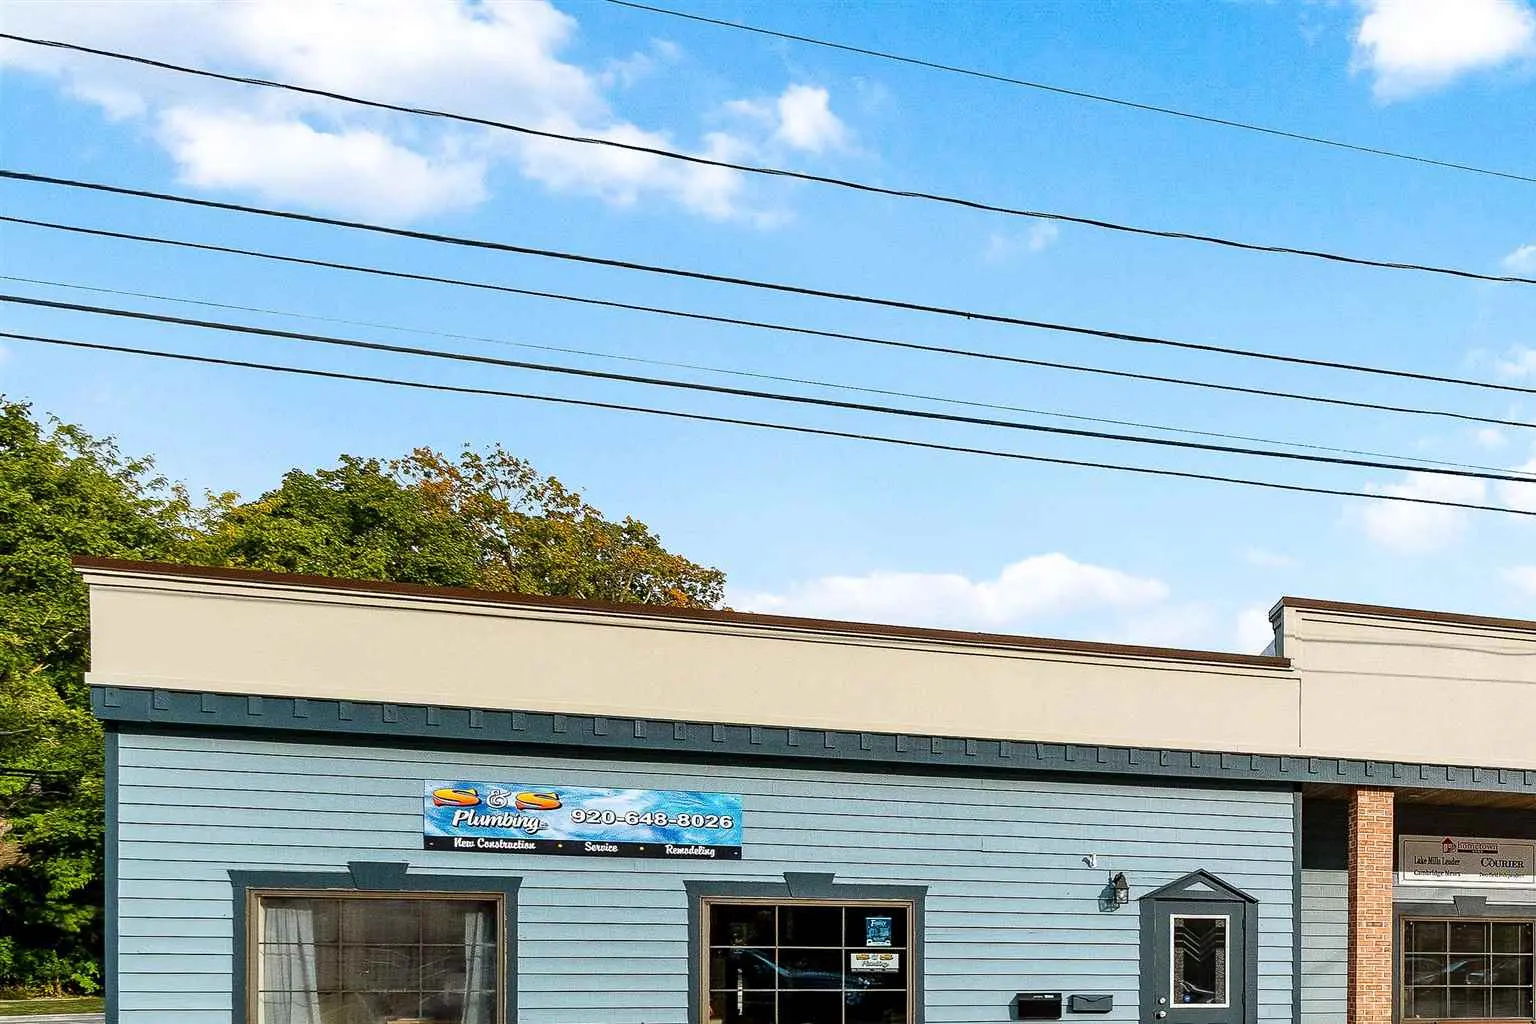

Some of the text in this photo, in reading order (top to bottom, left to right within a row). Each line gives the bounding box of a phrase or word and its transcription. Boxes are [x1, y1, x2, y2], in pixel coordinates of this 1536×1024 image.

[431, 787, 563, 811] S & S
[452, 809, 541, 835] Plumbing
[570, 808, 735, 830] 920-648-8026
[453, 837, 537, 850] New Construction
[584, 841, 619, 854] Service
[665, 844, 716, 858] Remodeling
[1414, 855, 1461, 866] Lake Mills Leader
